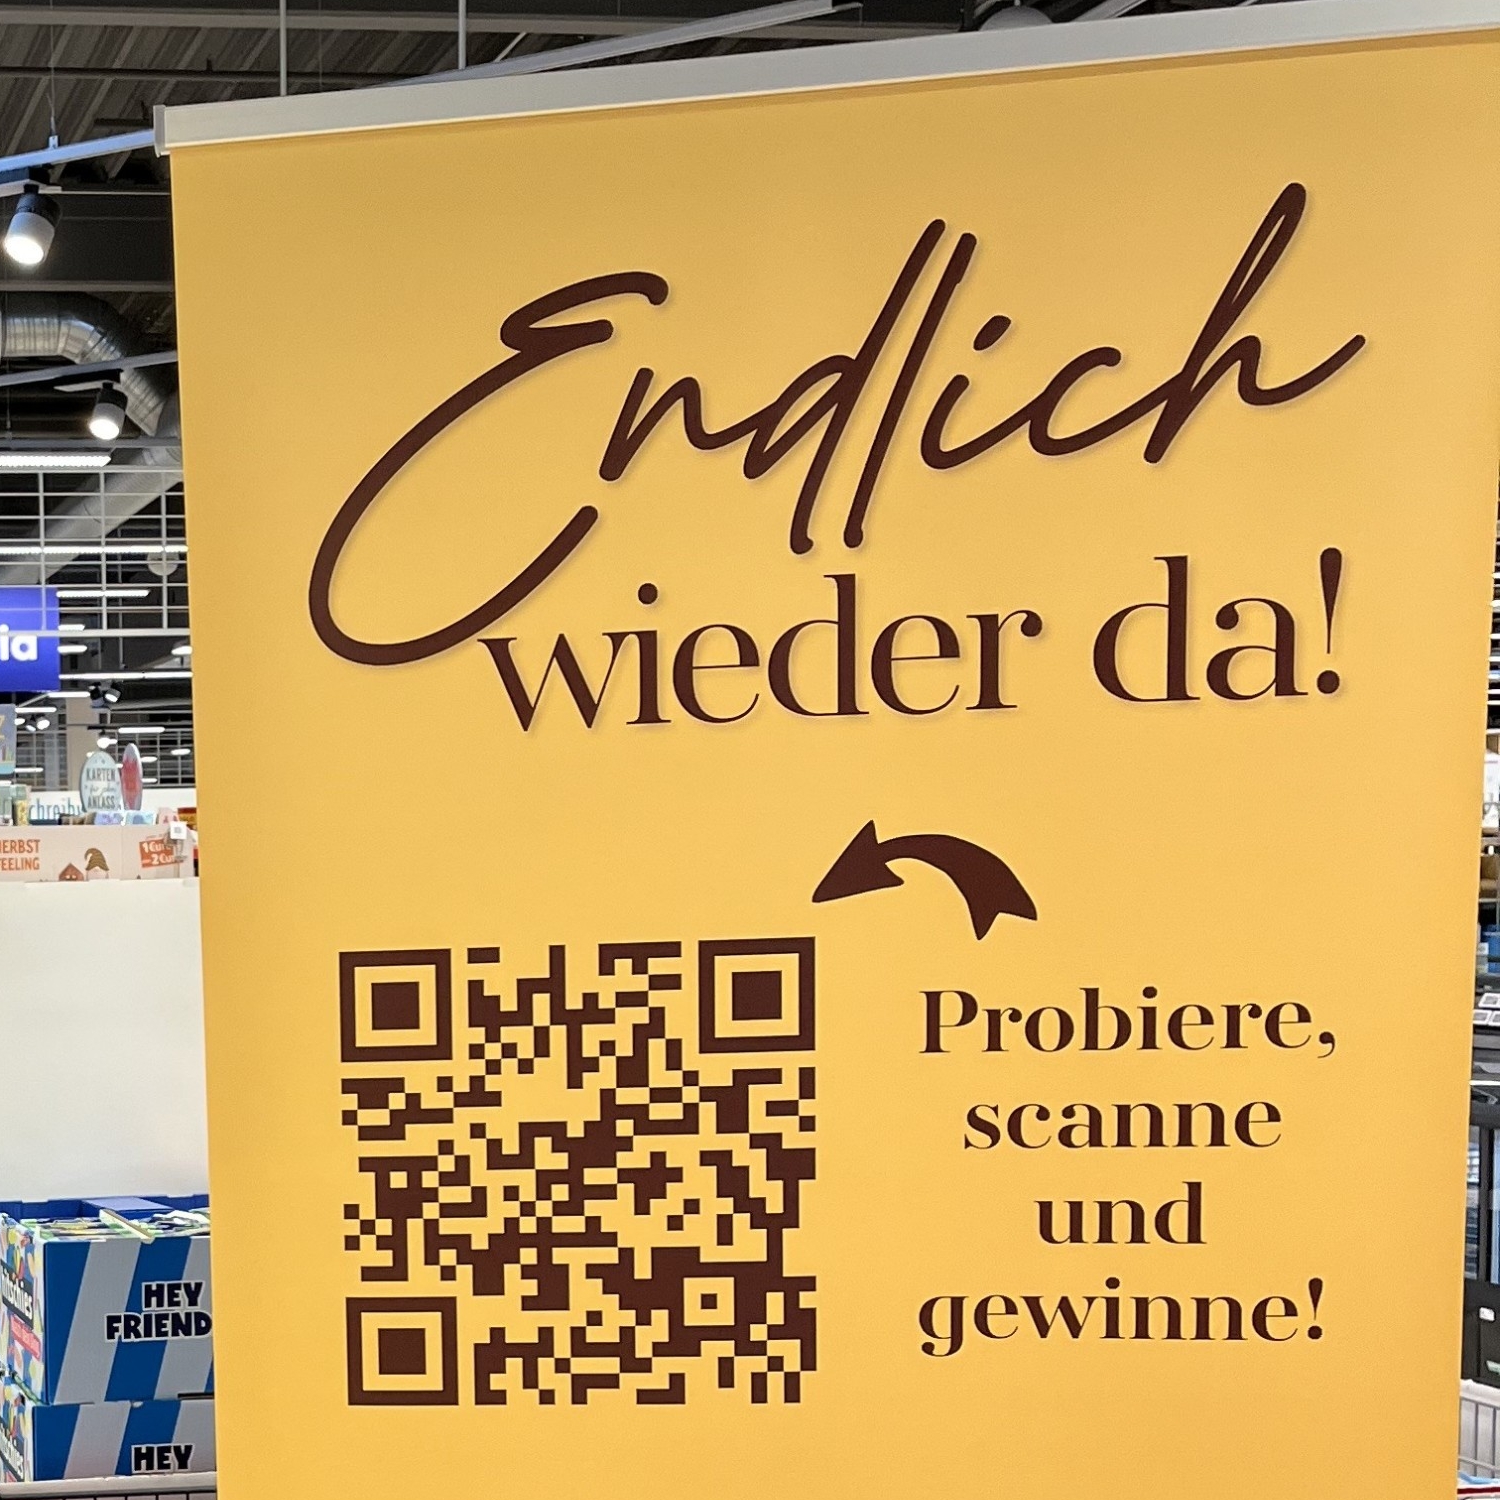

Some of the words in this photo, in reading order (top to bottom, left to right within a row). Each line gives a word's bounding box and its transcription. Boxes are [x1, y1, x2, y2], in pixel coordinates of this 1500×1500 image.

[309, 182, 1366, 666] Endlich
[477, 574, 1043, 733] wieder
[1092, 546, 1342, 704] da!
[919, 985, 1337, 1059] Probiere,
[964, 1097, 1282, 1152] scanne
[1035, 1181, 1207, 1246] und
[105, 1311, 212, 1340] FRIEND
[143, 1282, 203, 1308] HEY
[917, 1278, 1325, 1358] gewinne!
[133, 1445, 193, 1472] HEY
